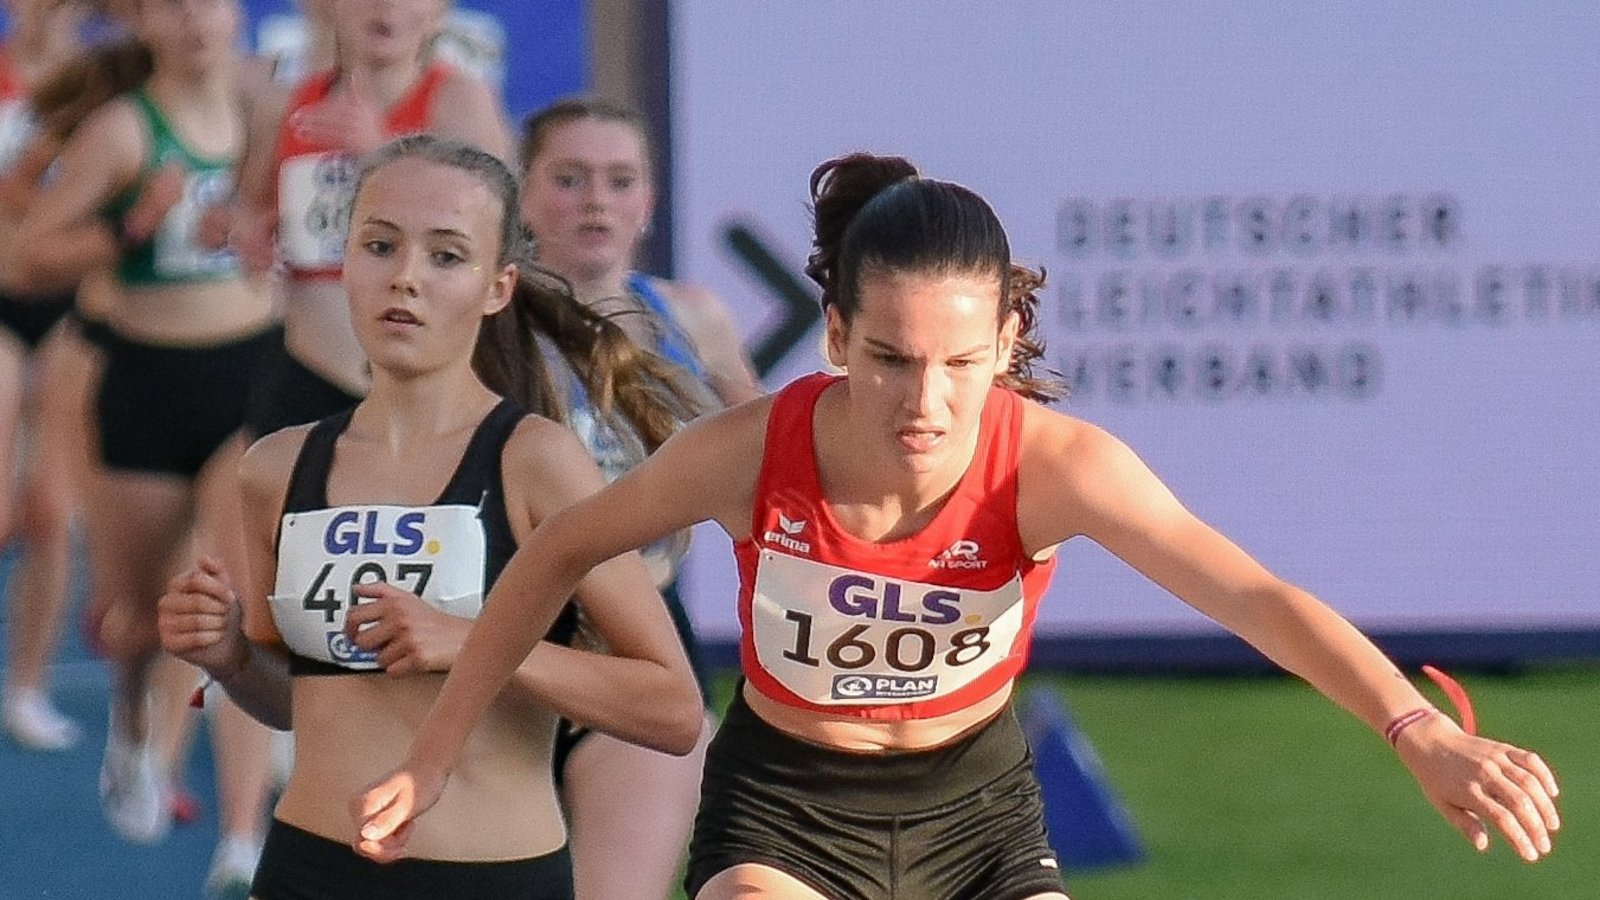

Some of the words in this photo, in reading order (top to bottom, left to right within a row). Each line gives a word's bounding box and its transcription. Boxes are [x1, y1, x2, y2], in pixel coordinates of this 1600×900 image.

[1057, 195, 1460, 255] DEUTSCHER
[1060, 342, 1382, 402] VERBAND
[764, 530, 811, 554] erima
[782, 608, 991, 673] 1608
[875, 677, 934, 692] PLAN
